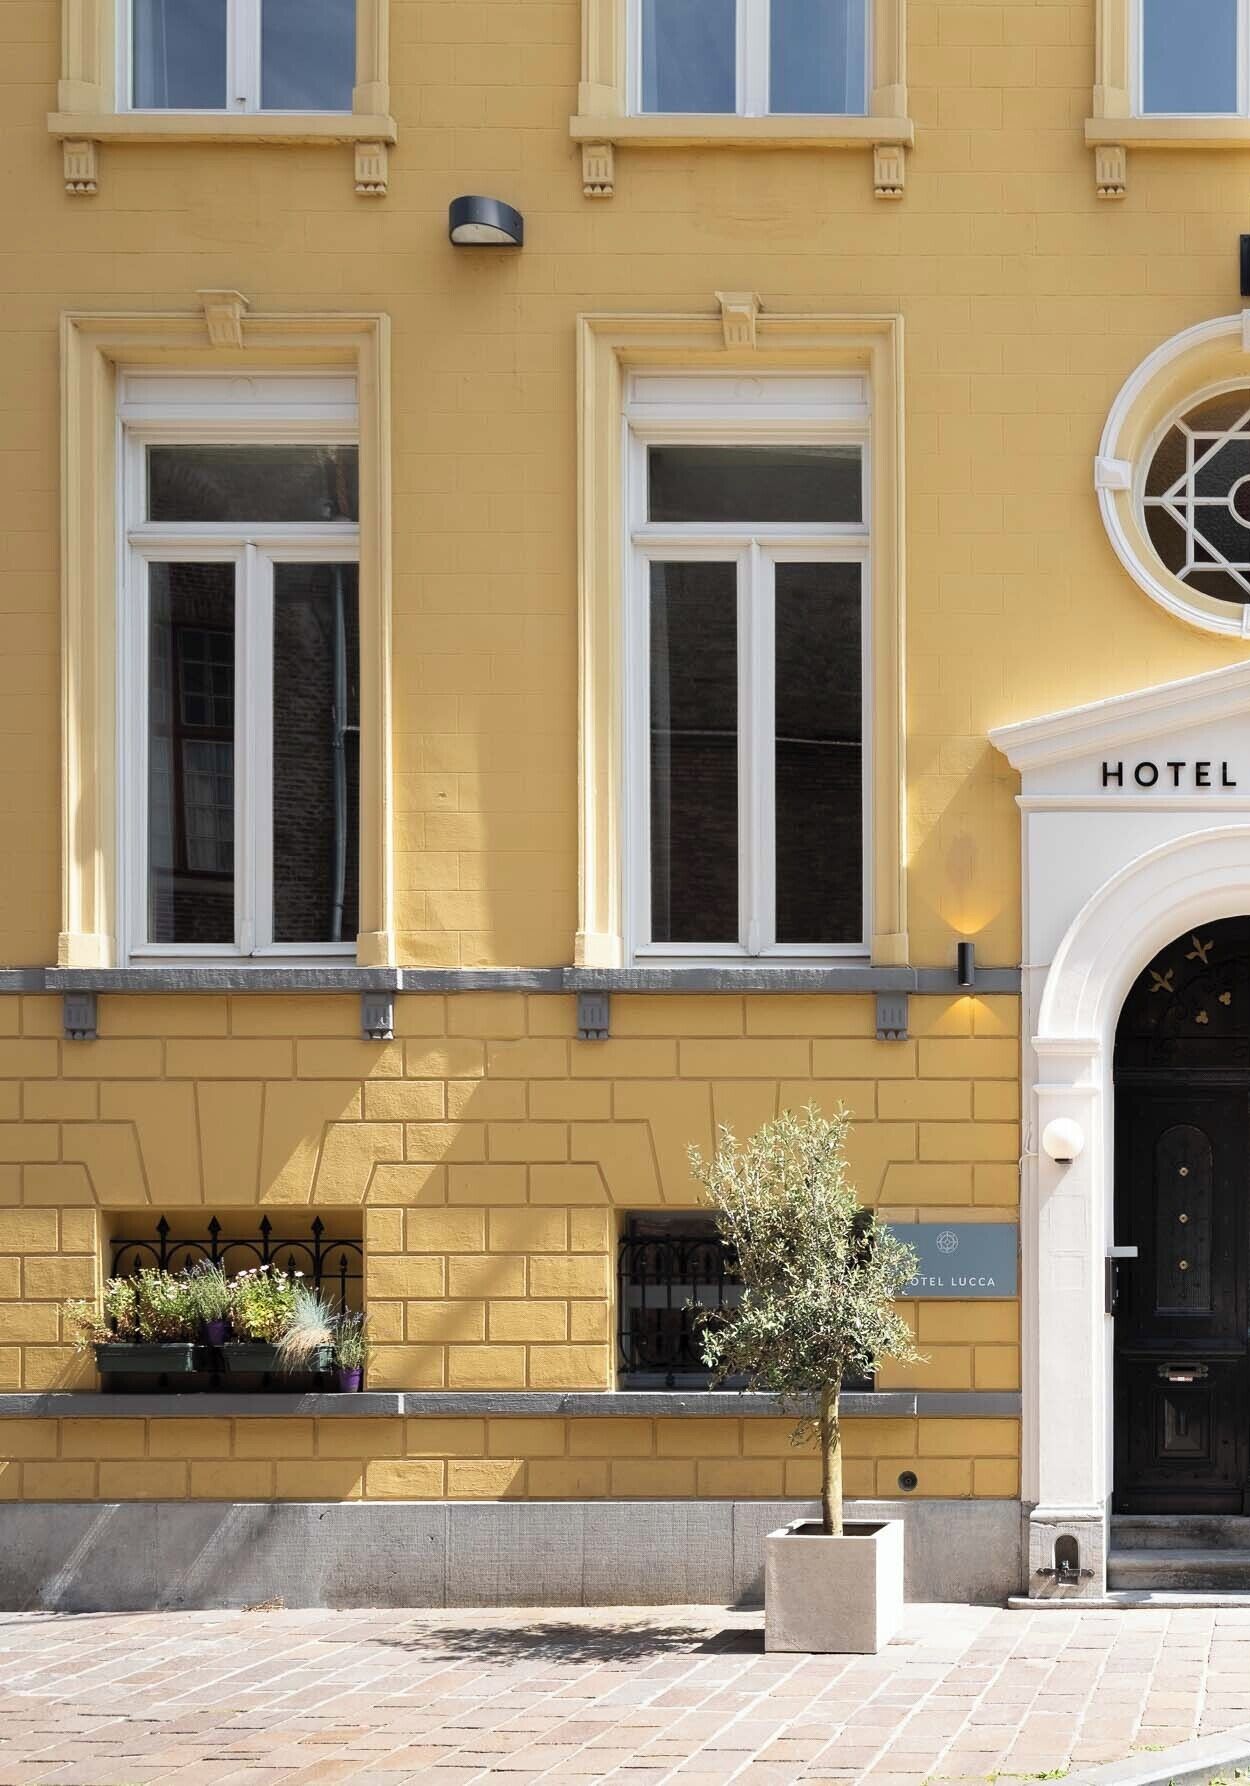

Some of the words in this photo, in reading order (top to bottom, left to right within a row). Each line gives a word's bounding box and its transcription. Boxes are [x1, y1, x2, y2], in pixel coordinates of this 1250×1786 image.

[1101, 761, 1238, 788] HOTEL
[904, 1276, 945, 1287] OTEL
[950, 1276, 996, 1287] LUCCA
